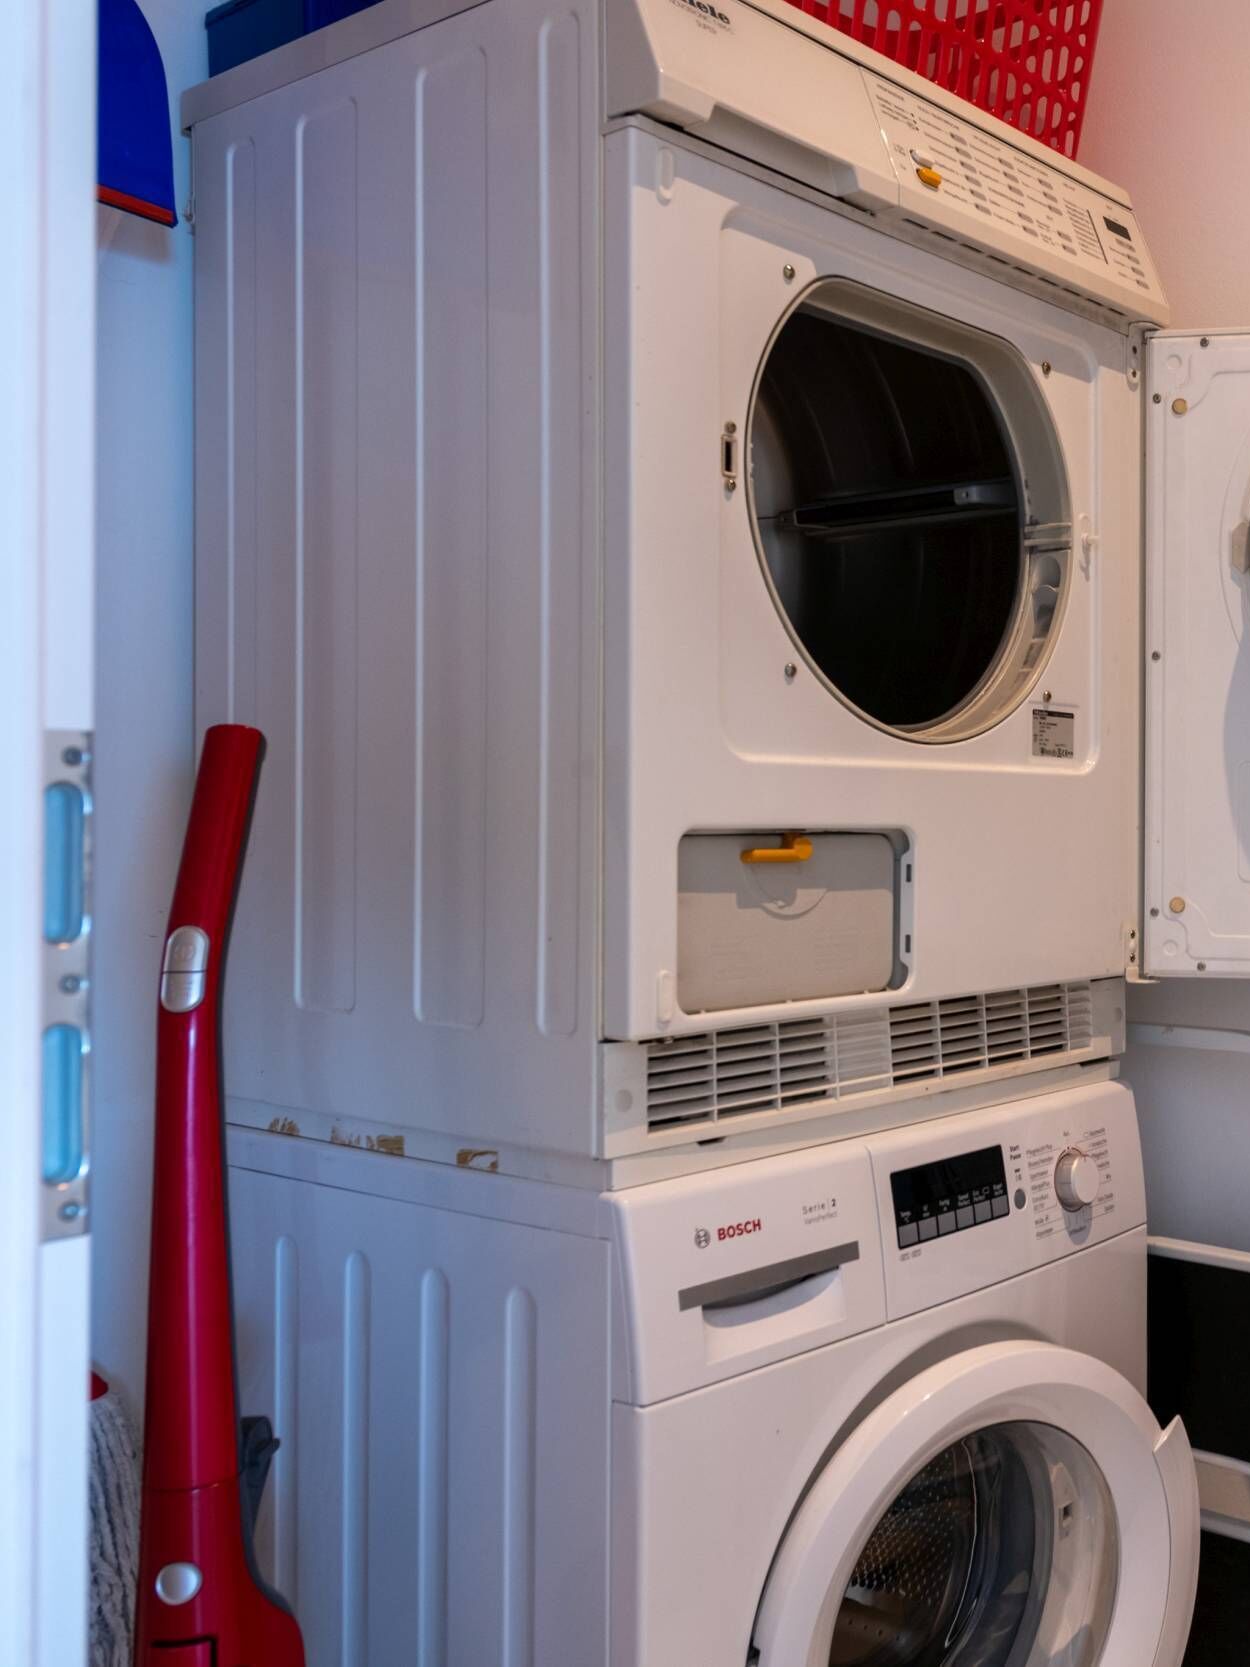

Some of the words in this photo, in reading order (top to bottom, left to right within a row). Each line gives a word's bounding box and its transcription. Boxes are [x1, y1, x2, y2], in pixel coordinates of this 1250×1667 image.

[802, 1203, 826, 1215] Serie
[831, 1198, 836, 1207] 2
[717, 1219, 762, 1241] BOSCH
